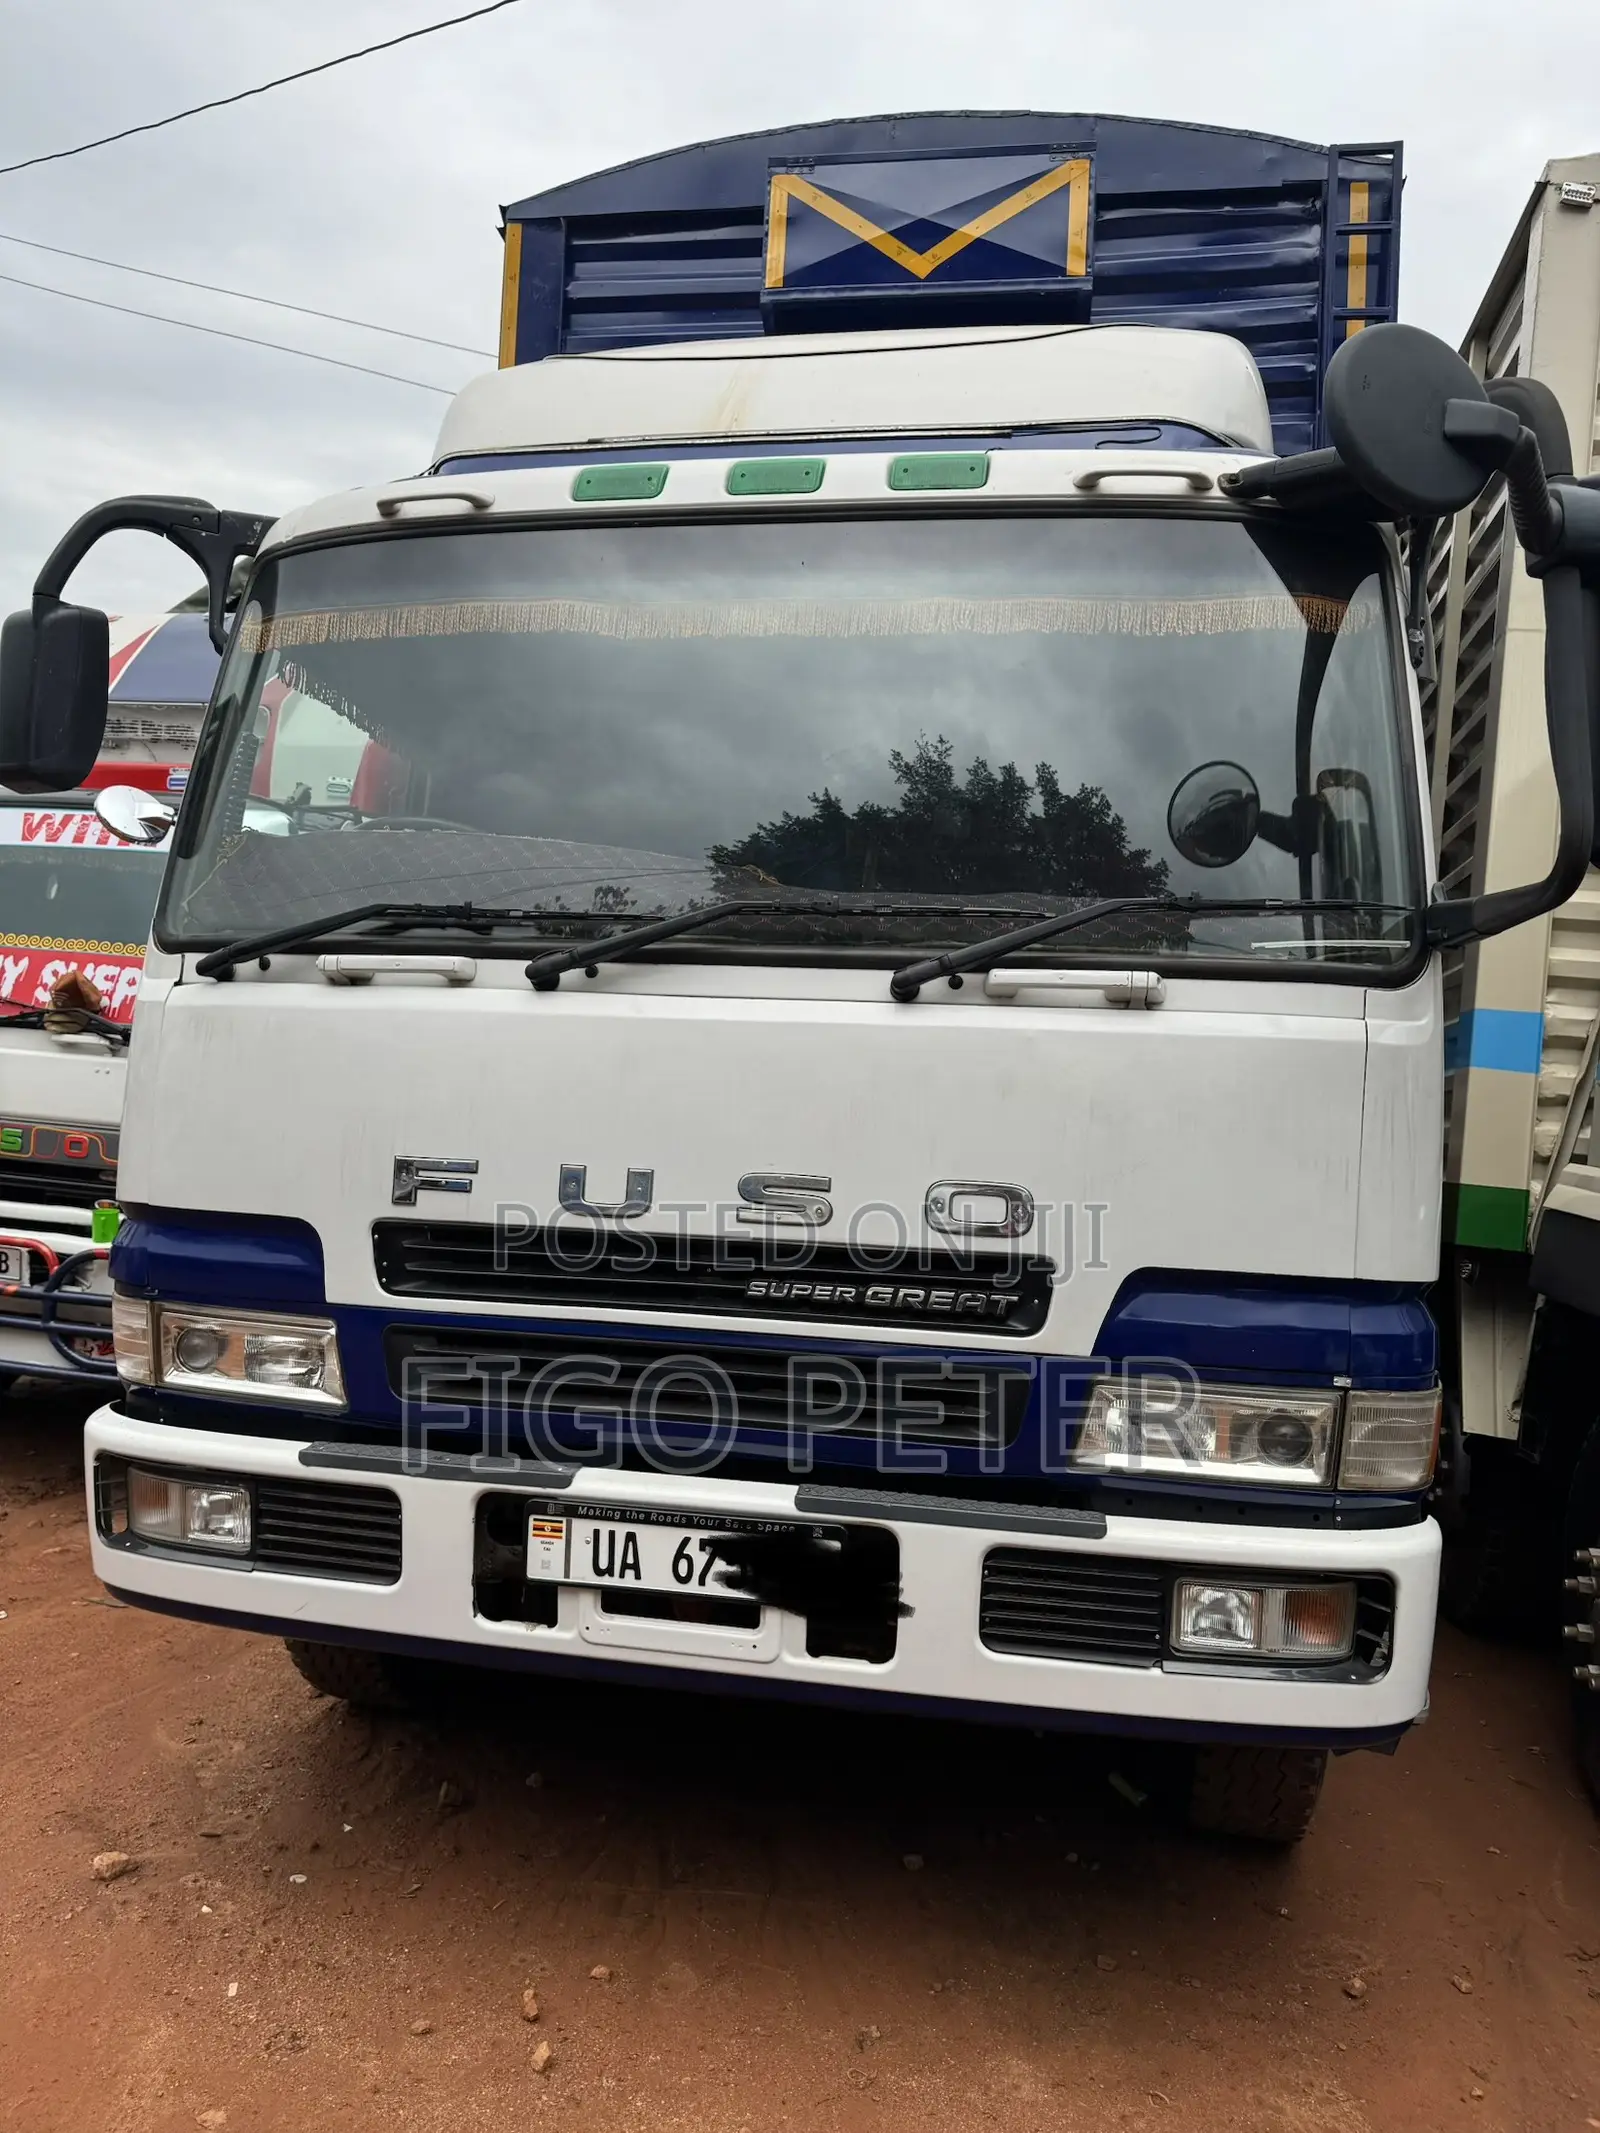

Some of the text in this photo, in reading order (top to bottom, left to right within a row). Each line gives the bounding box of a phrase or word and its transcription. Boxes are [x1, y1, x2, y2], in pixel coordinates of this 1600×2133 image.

[21, 812, 157, 848] WIT
[0, 954, 29, 1000] Y
[391, 1154, 1034, 1238] FUSO
[747, 1280, 1022, 1317] SUPER GREAT
[577, 1506, 621, 1520] Making
[626, 1510, 645, 1520] the
[650, 1512, 687, 1525] Roads
[693, 1516, 720, 1527] Your
[592, 1528, 642, 1580] UA
